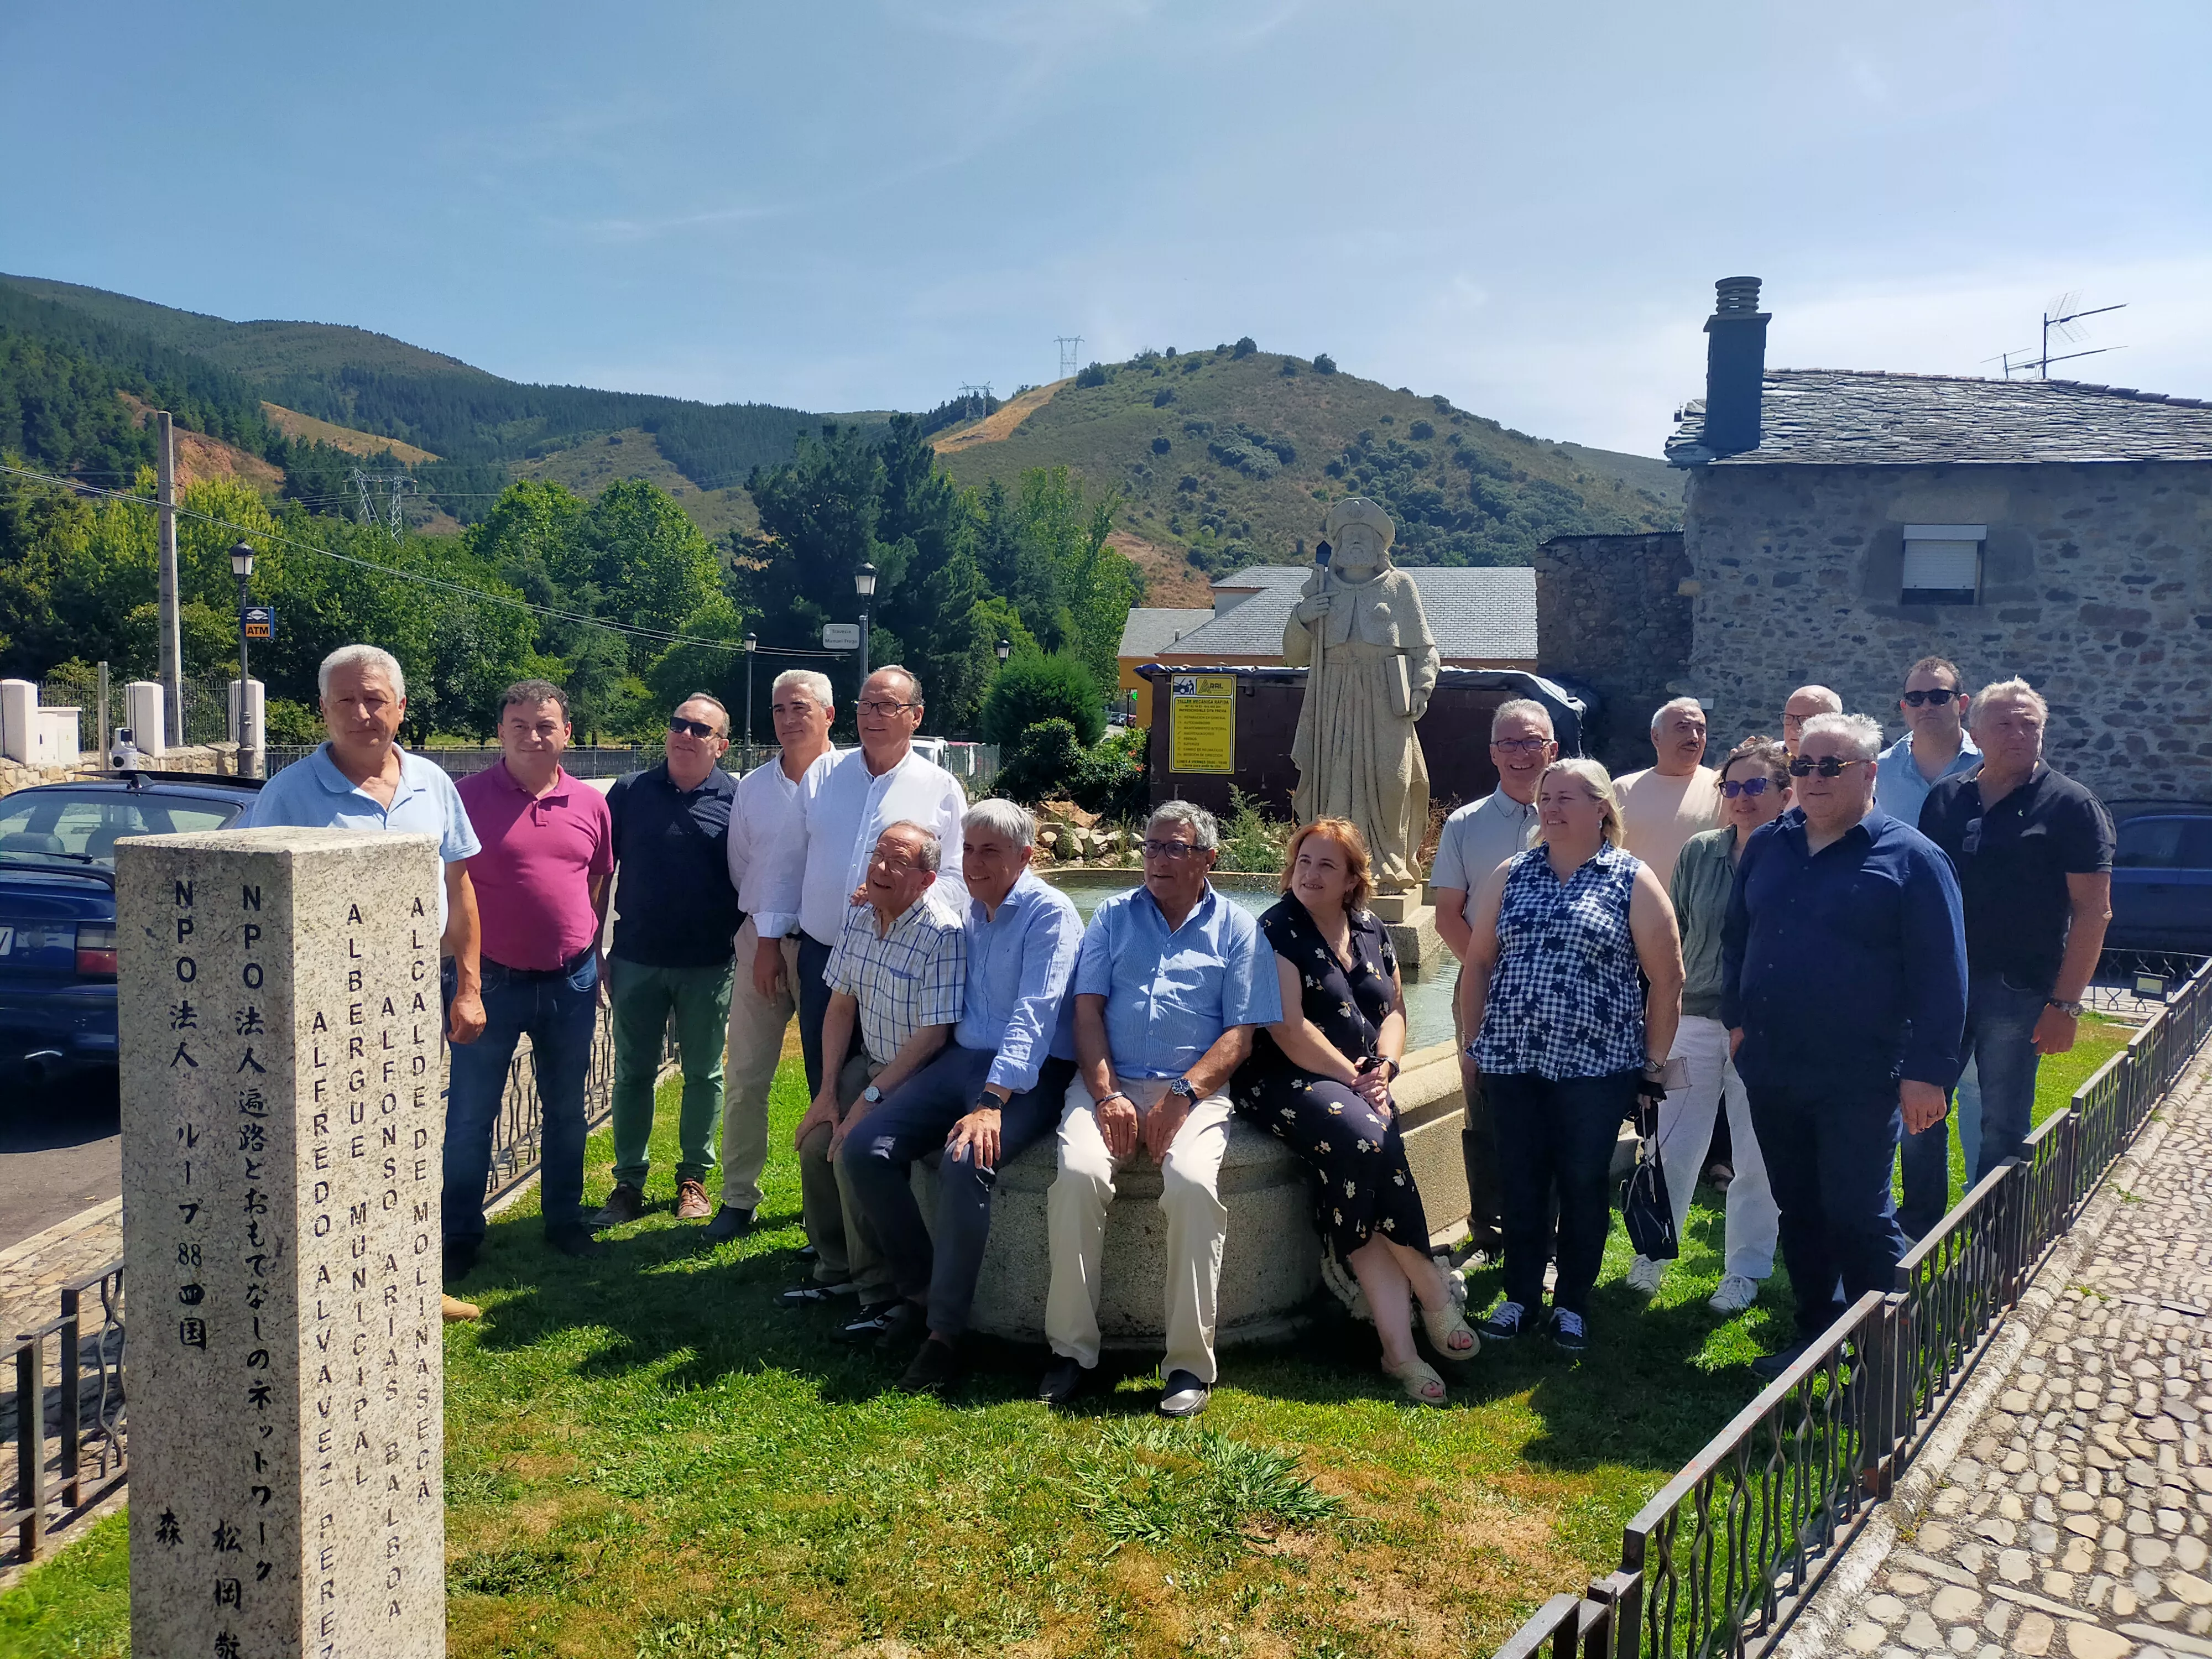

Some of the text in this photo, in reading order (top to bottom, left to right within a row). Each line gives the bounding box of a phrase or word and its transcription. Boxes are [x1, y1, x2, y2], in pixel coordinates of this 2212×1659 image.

[247, 627, 268, 635] ATM
[312, 1011, 331, 1238] ALFREDO
[347, 904, 369, 1485] ALBERGUE MUNICIPAL
[382, 997, 401, 1623] ALFONSO ARIAS BALBOA
[411, 897, 430, 1504] ALCALDE DE MOLINASECA
